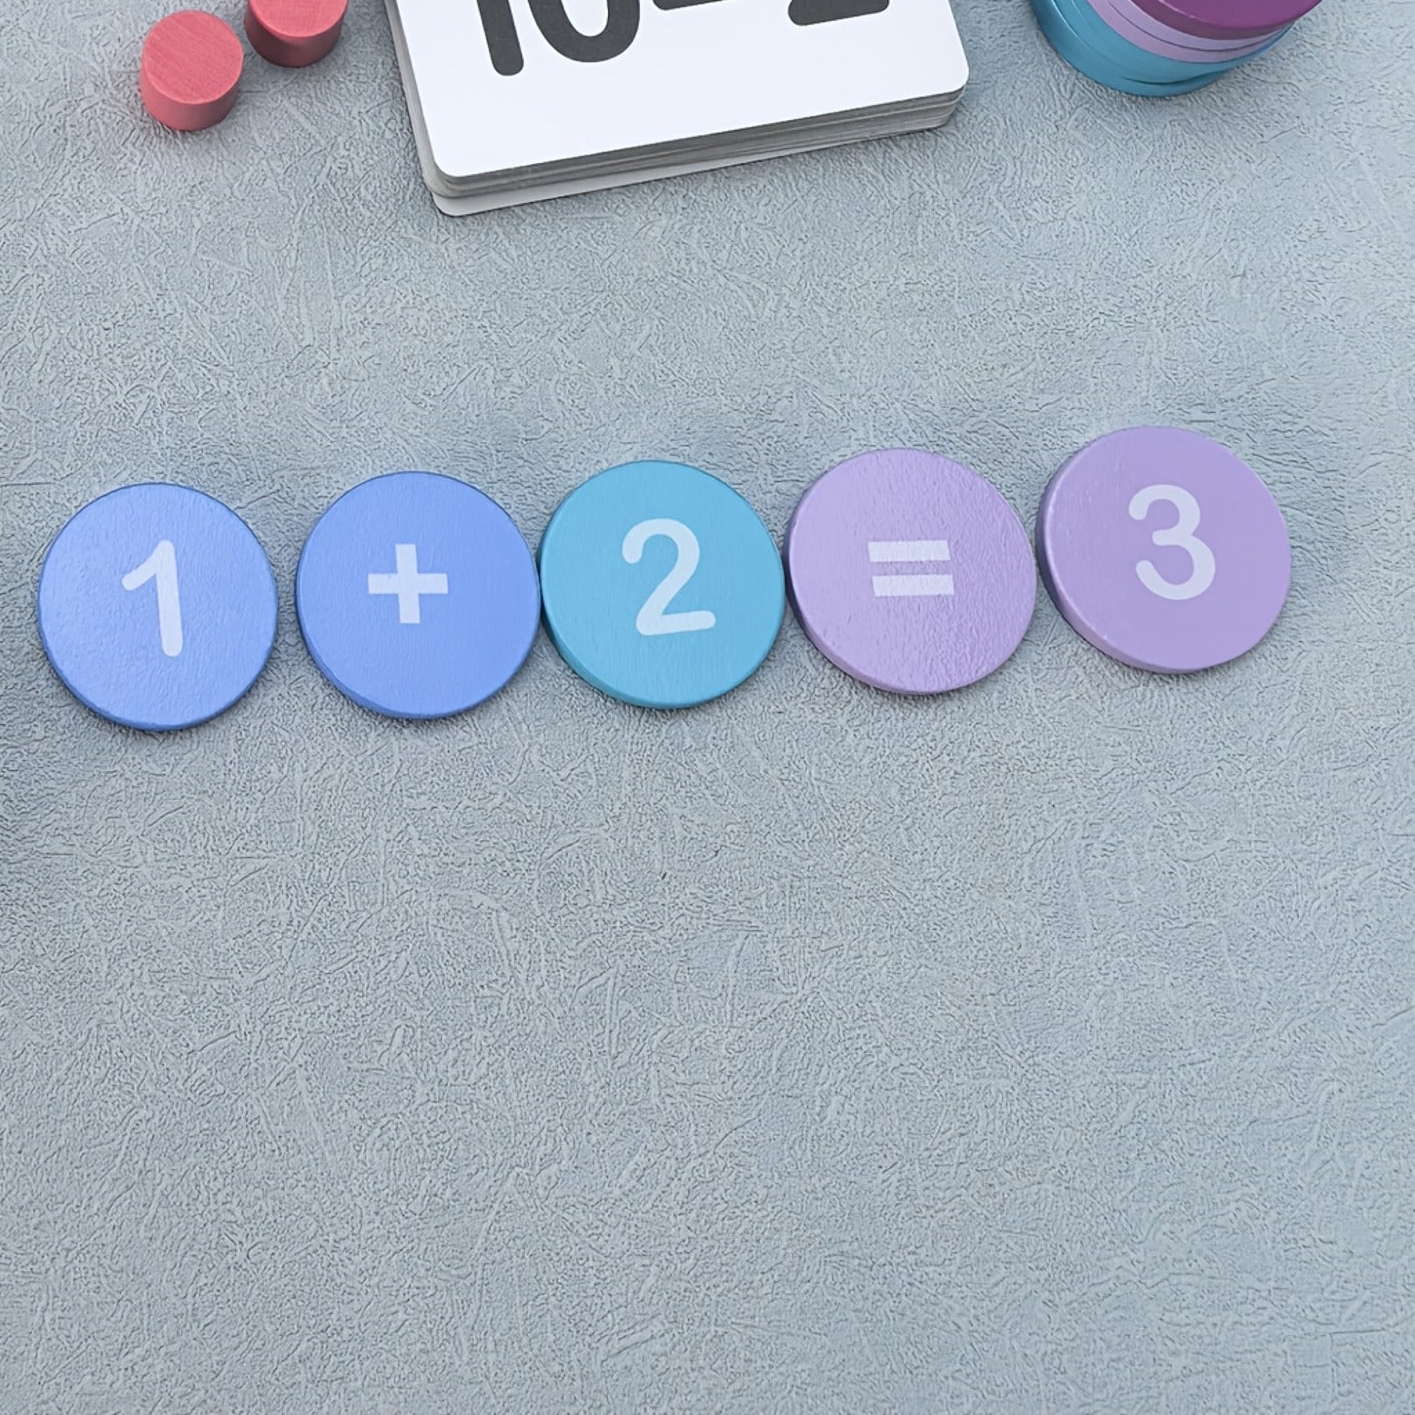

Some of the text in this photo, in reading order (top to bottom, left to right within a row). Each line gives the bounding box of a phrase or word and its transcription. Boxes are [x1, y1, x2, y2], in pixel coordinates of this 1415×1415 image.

[122, 485, 1215, 656] 1 + 2 = 3
